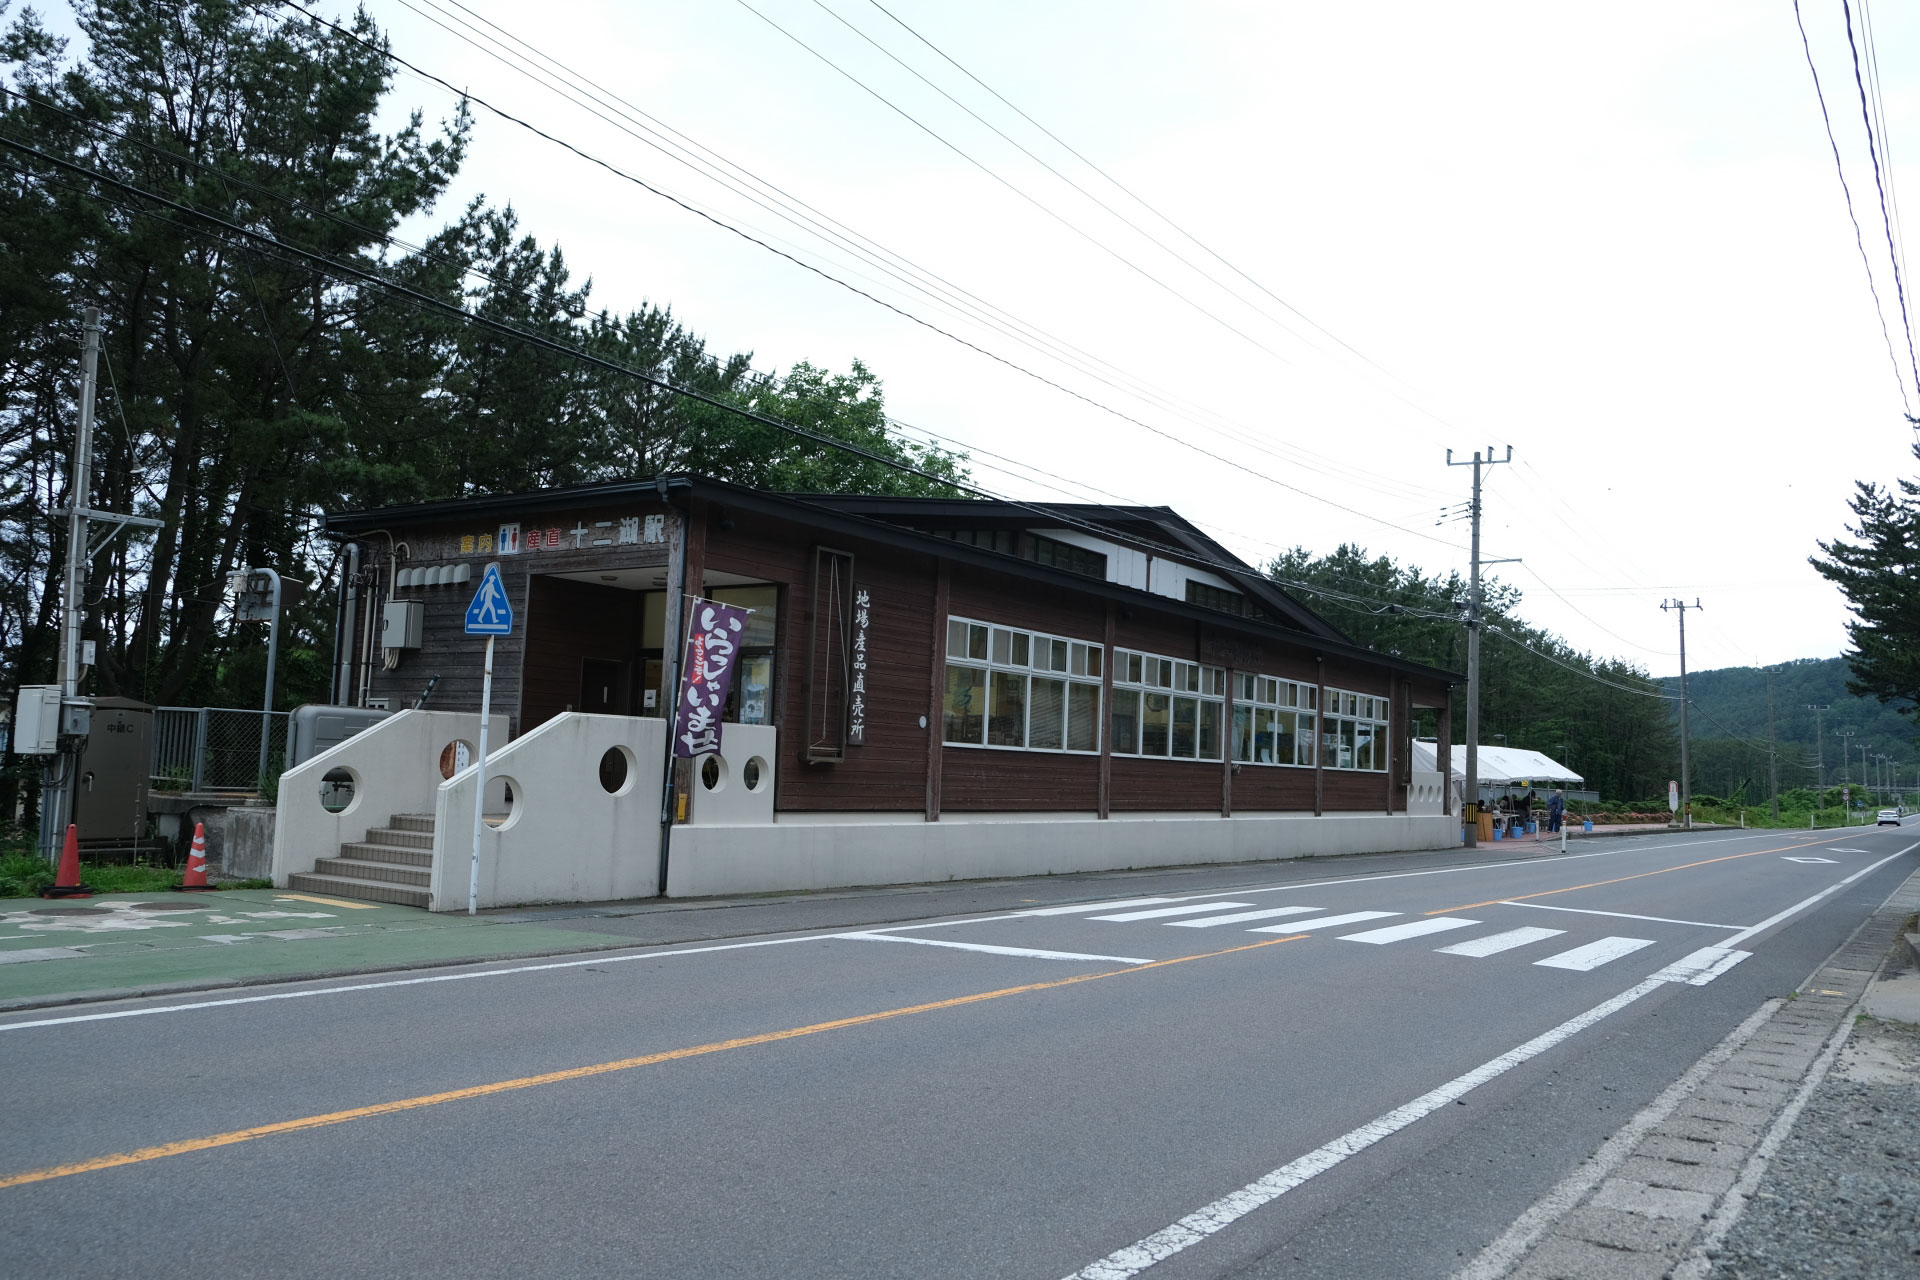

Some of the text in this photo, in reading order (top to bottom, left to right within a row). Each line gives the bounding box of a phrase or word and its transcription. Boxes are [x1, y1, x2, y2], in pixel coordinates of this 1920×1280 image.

[461, 533, 493, 554] 案内
[527, 528, 562, 549] 産直
[570, 514, 665, 548] 十二湖駅
[680, 607, 742, 755] いらっしゃいませ
[851, 590, 870, 740] 地場産品直売所
